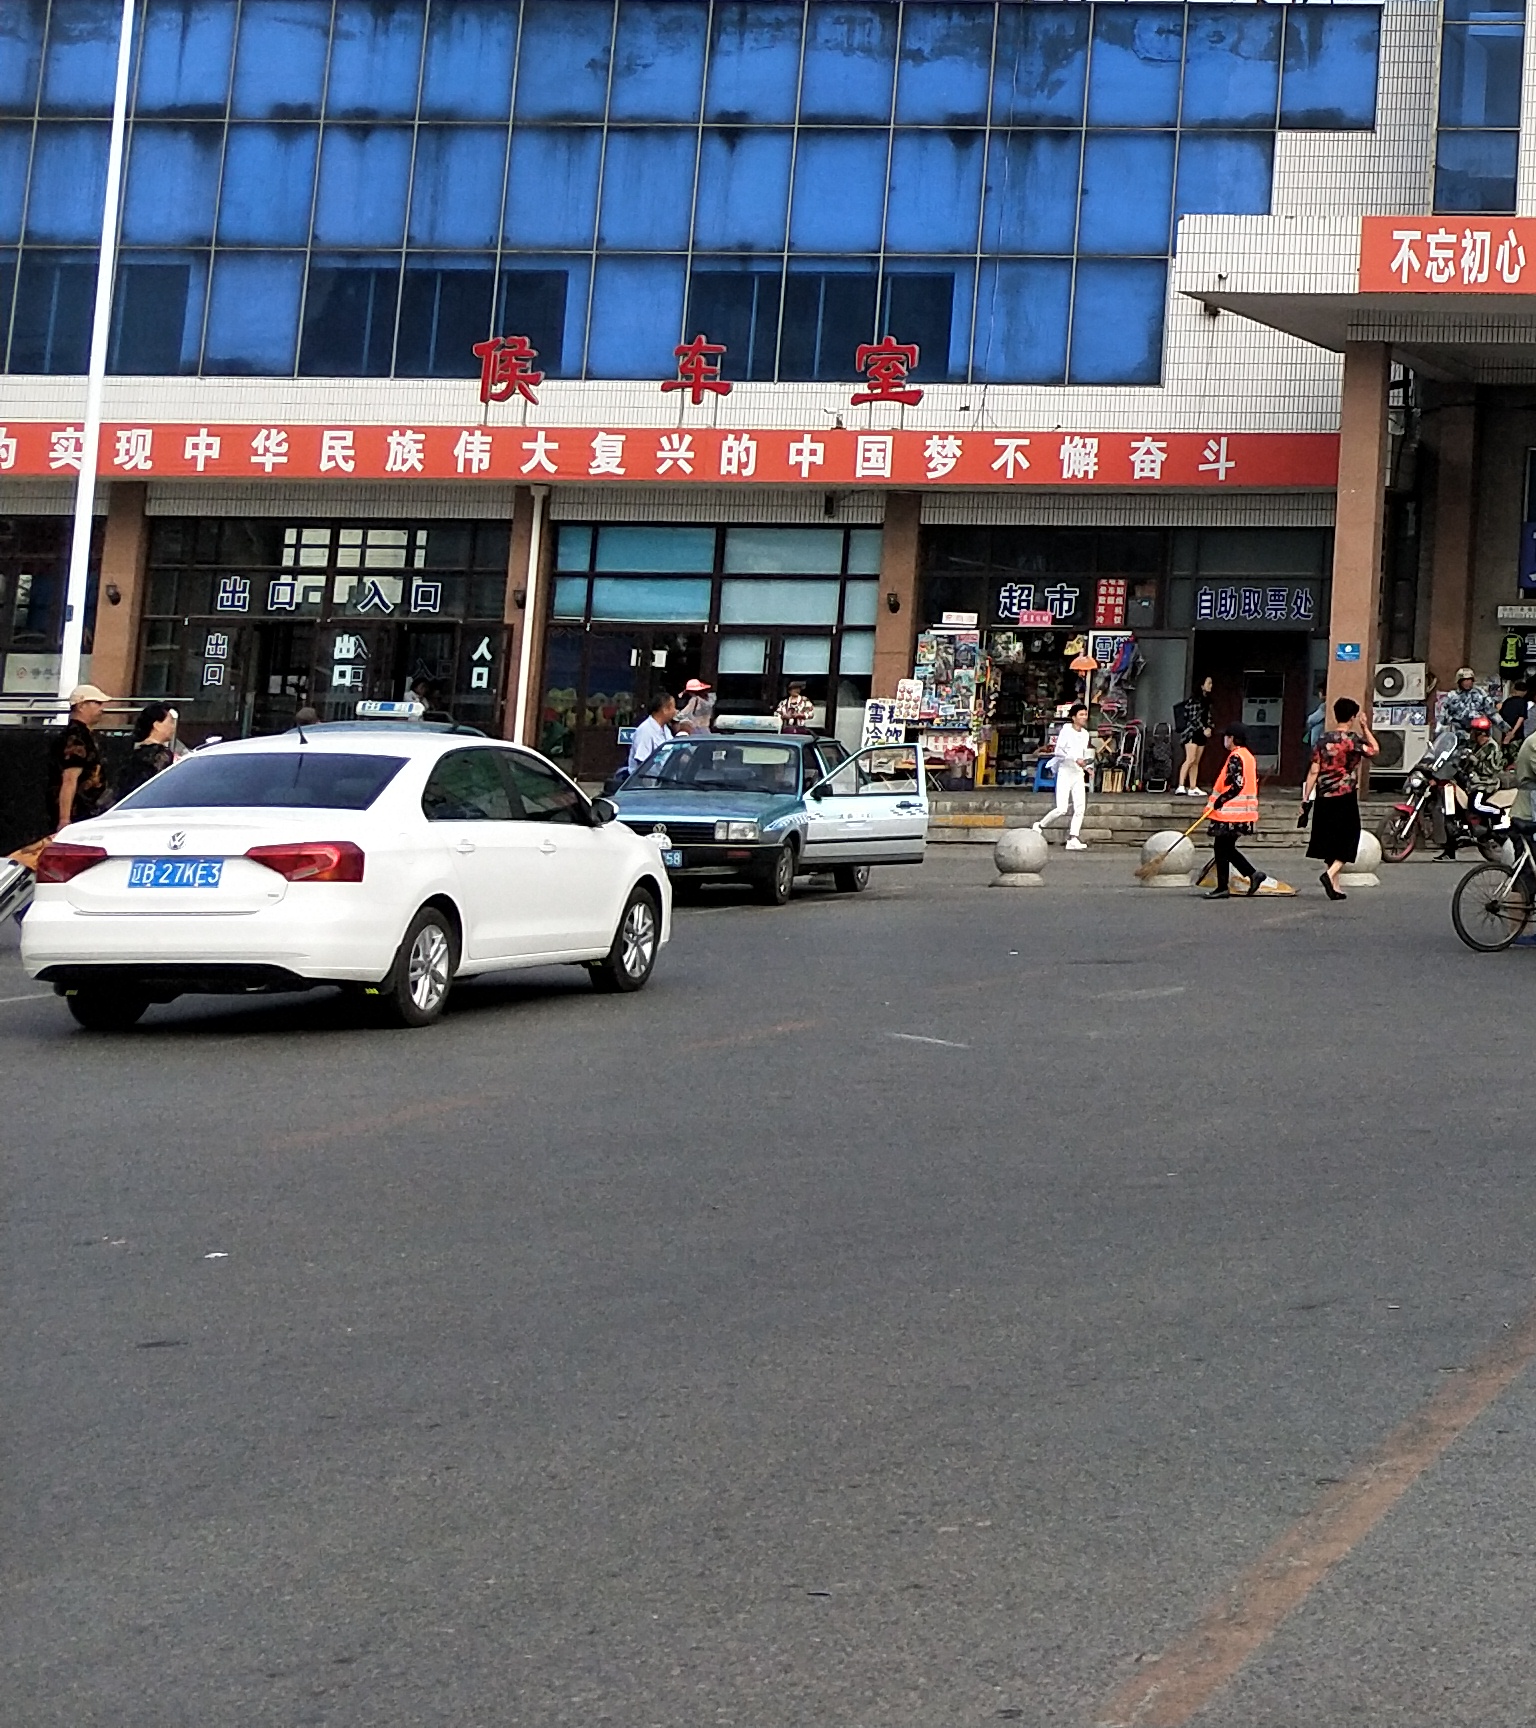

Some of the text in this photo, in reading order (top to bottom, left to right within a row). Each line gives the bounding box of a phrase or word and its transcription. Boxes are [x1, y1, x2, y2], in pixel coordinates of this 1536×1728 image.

[473, 334, 925, 406] 候车室
[216, 576, 443, 614] 出口 入口
[998, 582, 1080, 619] 超市
[1196, 585, 1315, 621] 自助取票处
[203, 632, 229, 687] 出口
